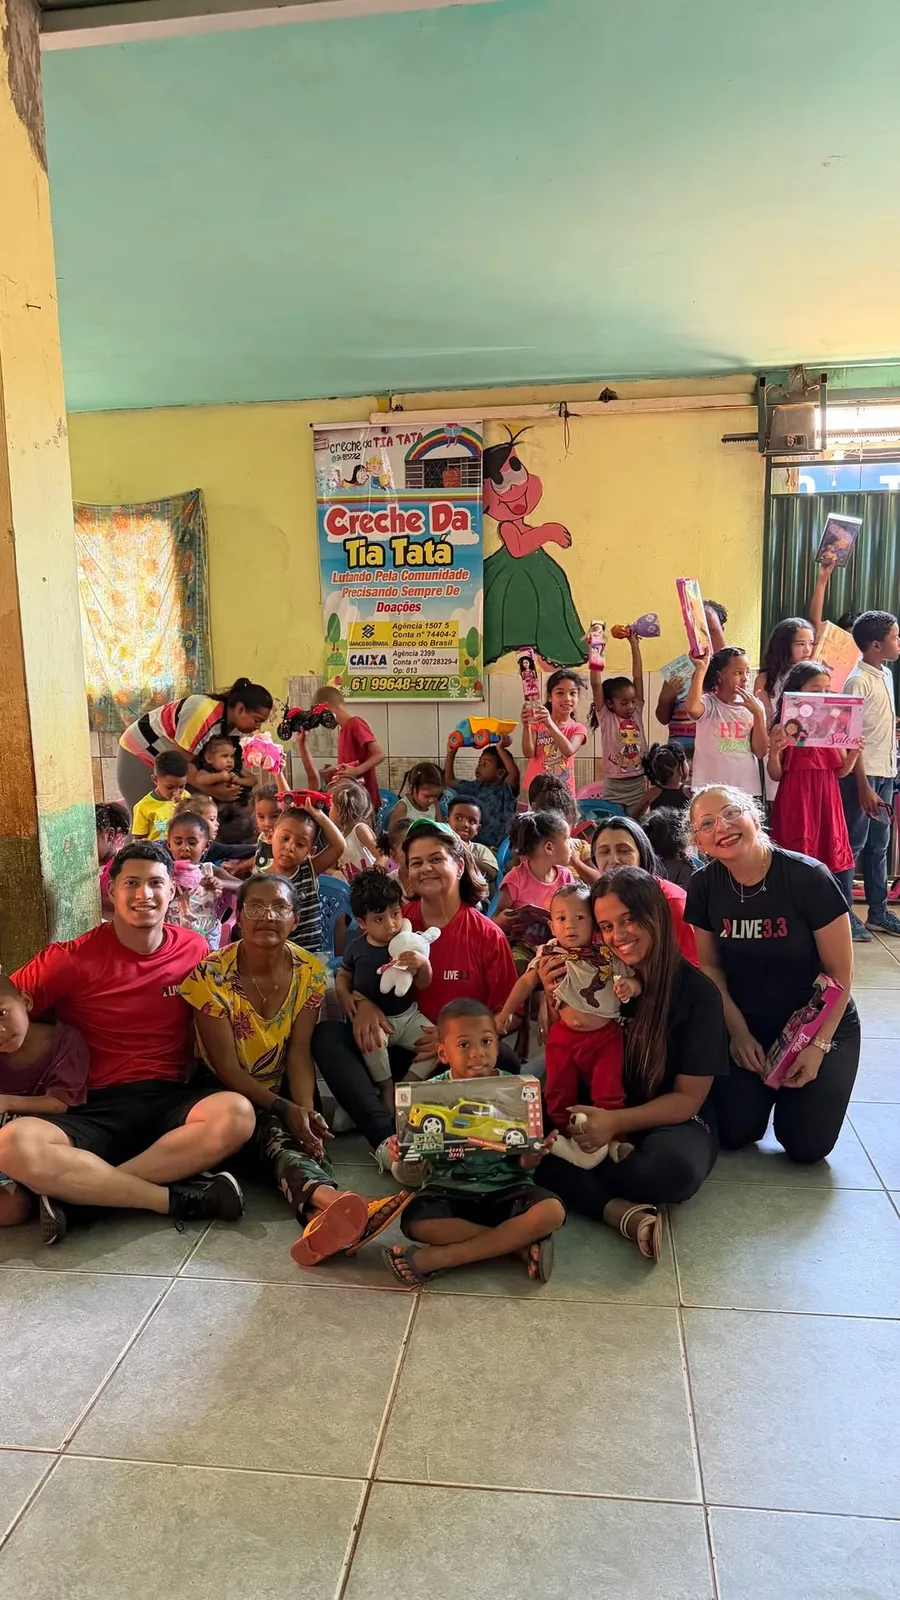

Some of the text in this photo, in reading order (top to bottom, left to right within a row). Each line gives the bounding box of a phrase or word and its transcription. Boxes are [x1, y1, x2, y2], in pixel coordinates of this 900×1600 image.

[330, 440, 362, 453] creche
[373, 436, 393, 448] TIA
[325, 502, 470, 537] Creche Da
[344, 534, 454, 567] Tia Tatá
[332, 569, 469, 583] Lutando Pela Comunidade
[342, 585, 460, 598] Precisando Sempre De
[376, 601, 422, 615] Doações
[392, 622, 422, 630] Agência
[350, 654, 387, 665] CAIXA
[351, 676, 449, 691] 61 99648-3772
[719, 720, 752, 739] HE
[732, 917, 788, 939] LIVE3.3
